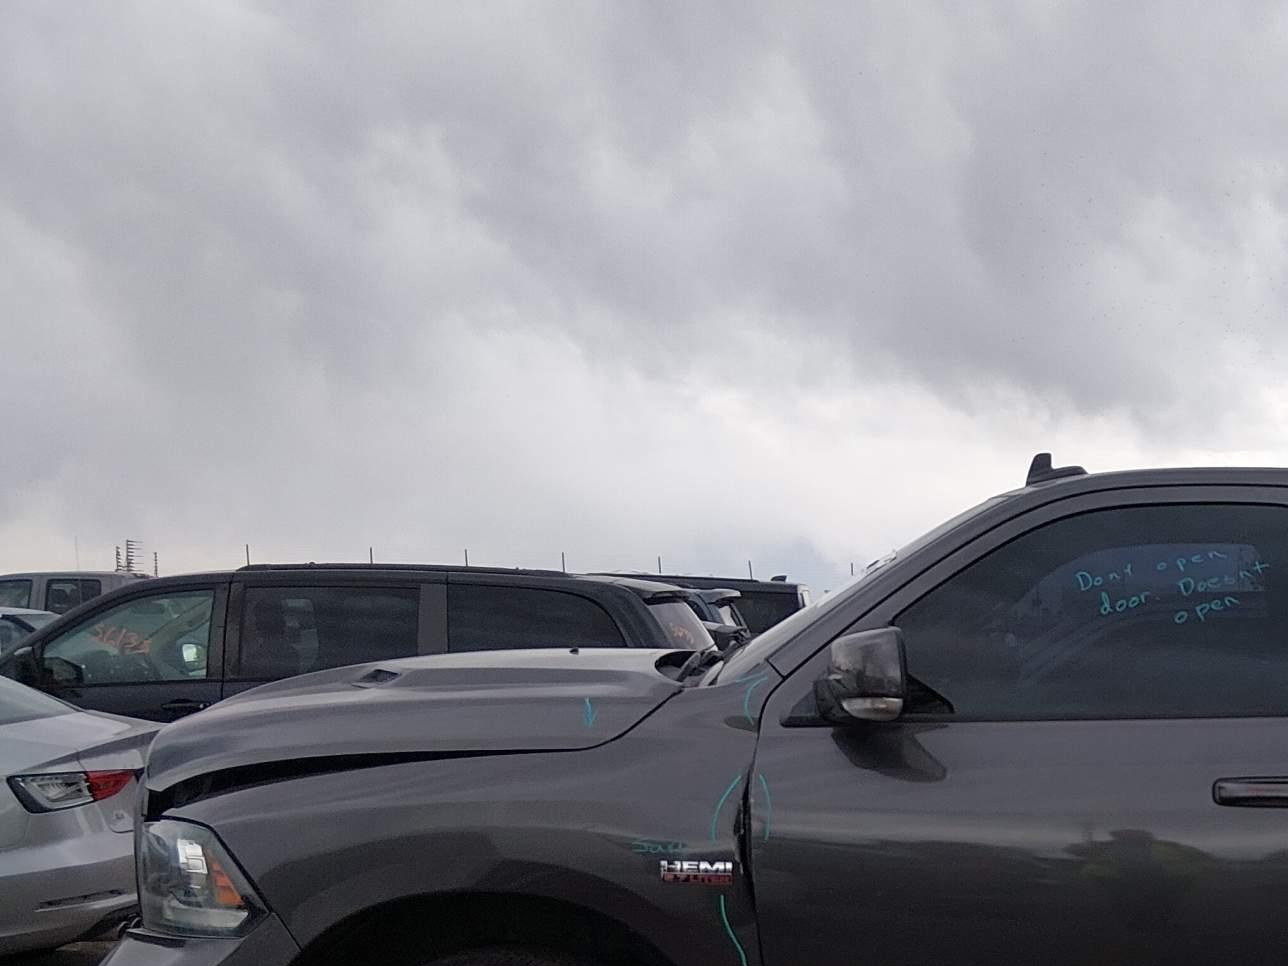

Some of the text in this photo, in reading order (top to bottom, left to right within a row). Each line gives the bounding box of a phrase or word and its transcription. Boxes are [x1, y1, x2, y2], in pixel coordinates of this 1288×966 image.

[1156, 550, 1227, 571] open
[1174, 597, 1241, 623] open
[660, 860, 733, 873] HEMI
